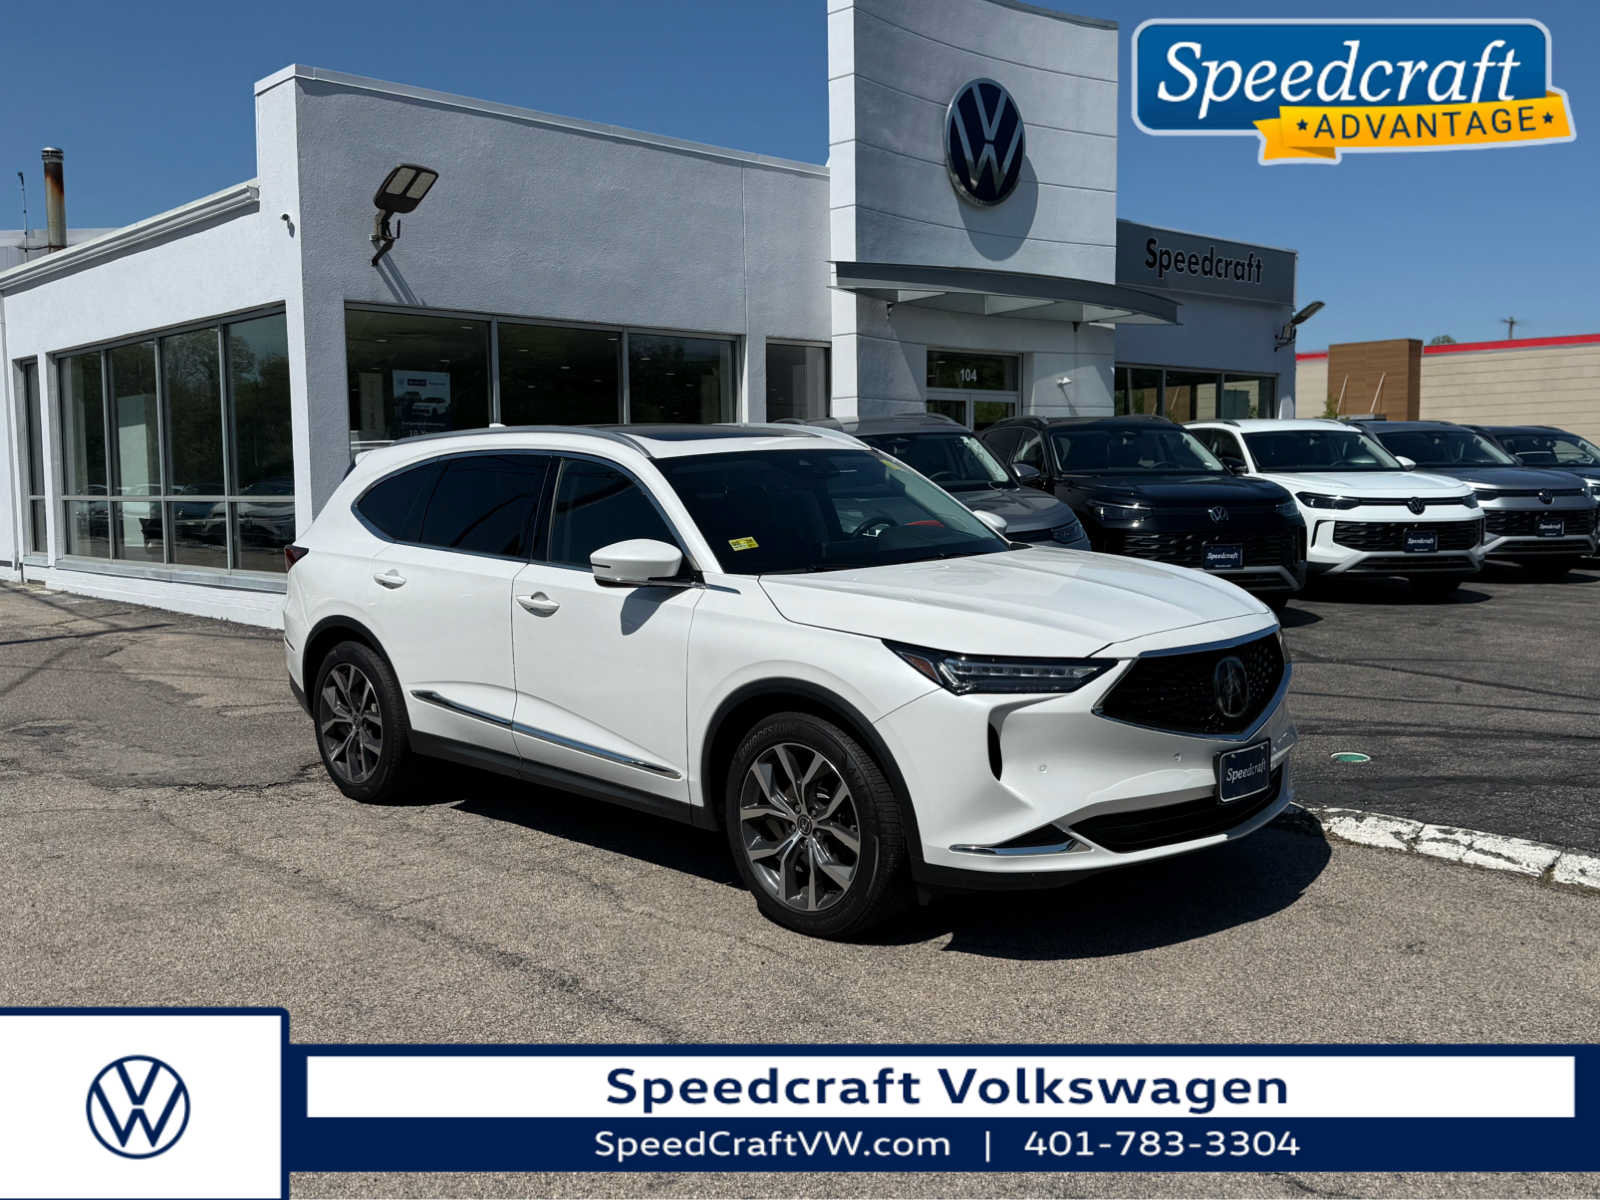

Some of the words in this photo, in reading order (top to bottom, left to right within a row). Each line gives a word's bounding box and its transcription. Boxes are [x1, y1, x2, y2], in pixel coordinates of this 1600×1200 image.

[1145, 237, 1264, 284] Speedcraft
[960, 368, 977, 382] 104
[1226, 757, 1266, 784] Speedcraft
